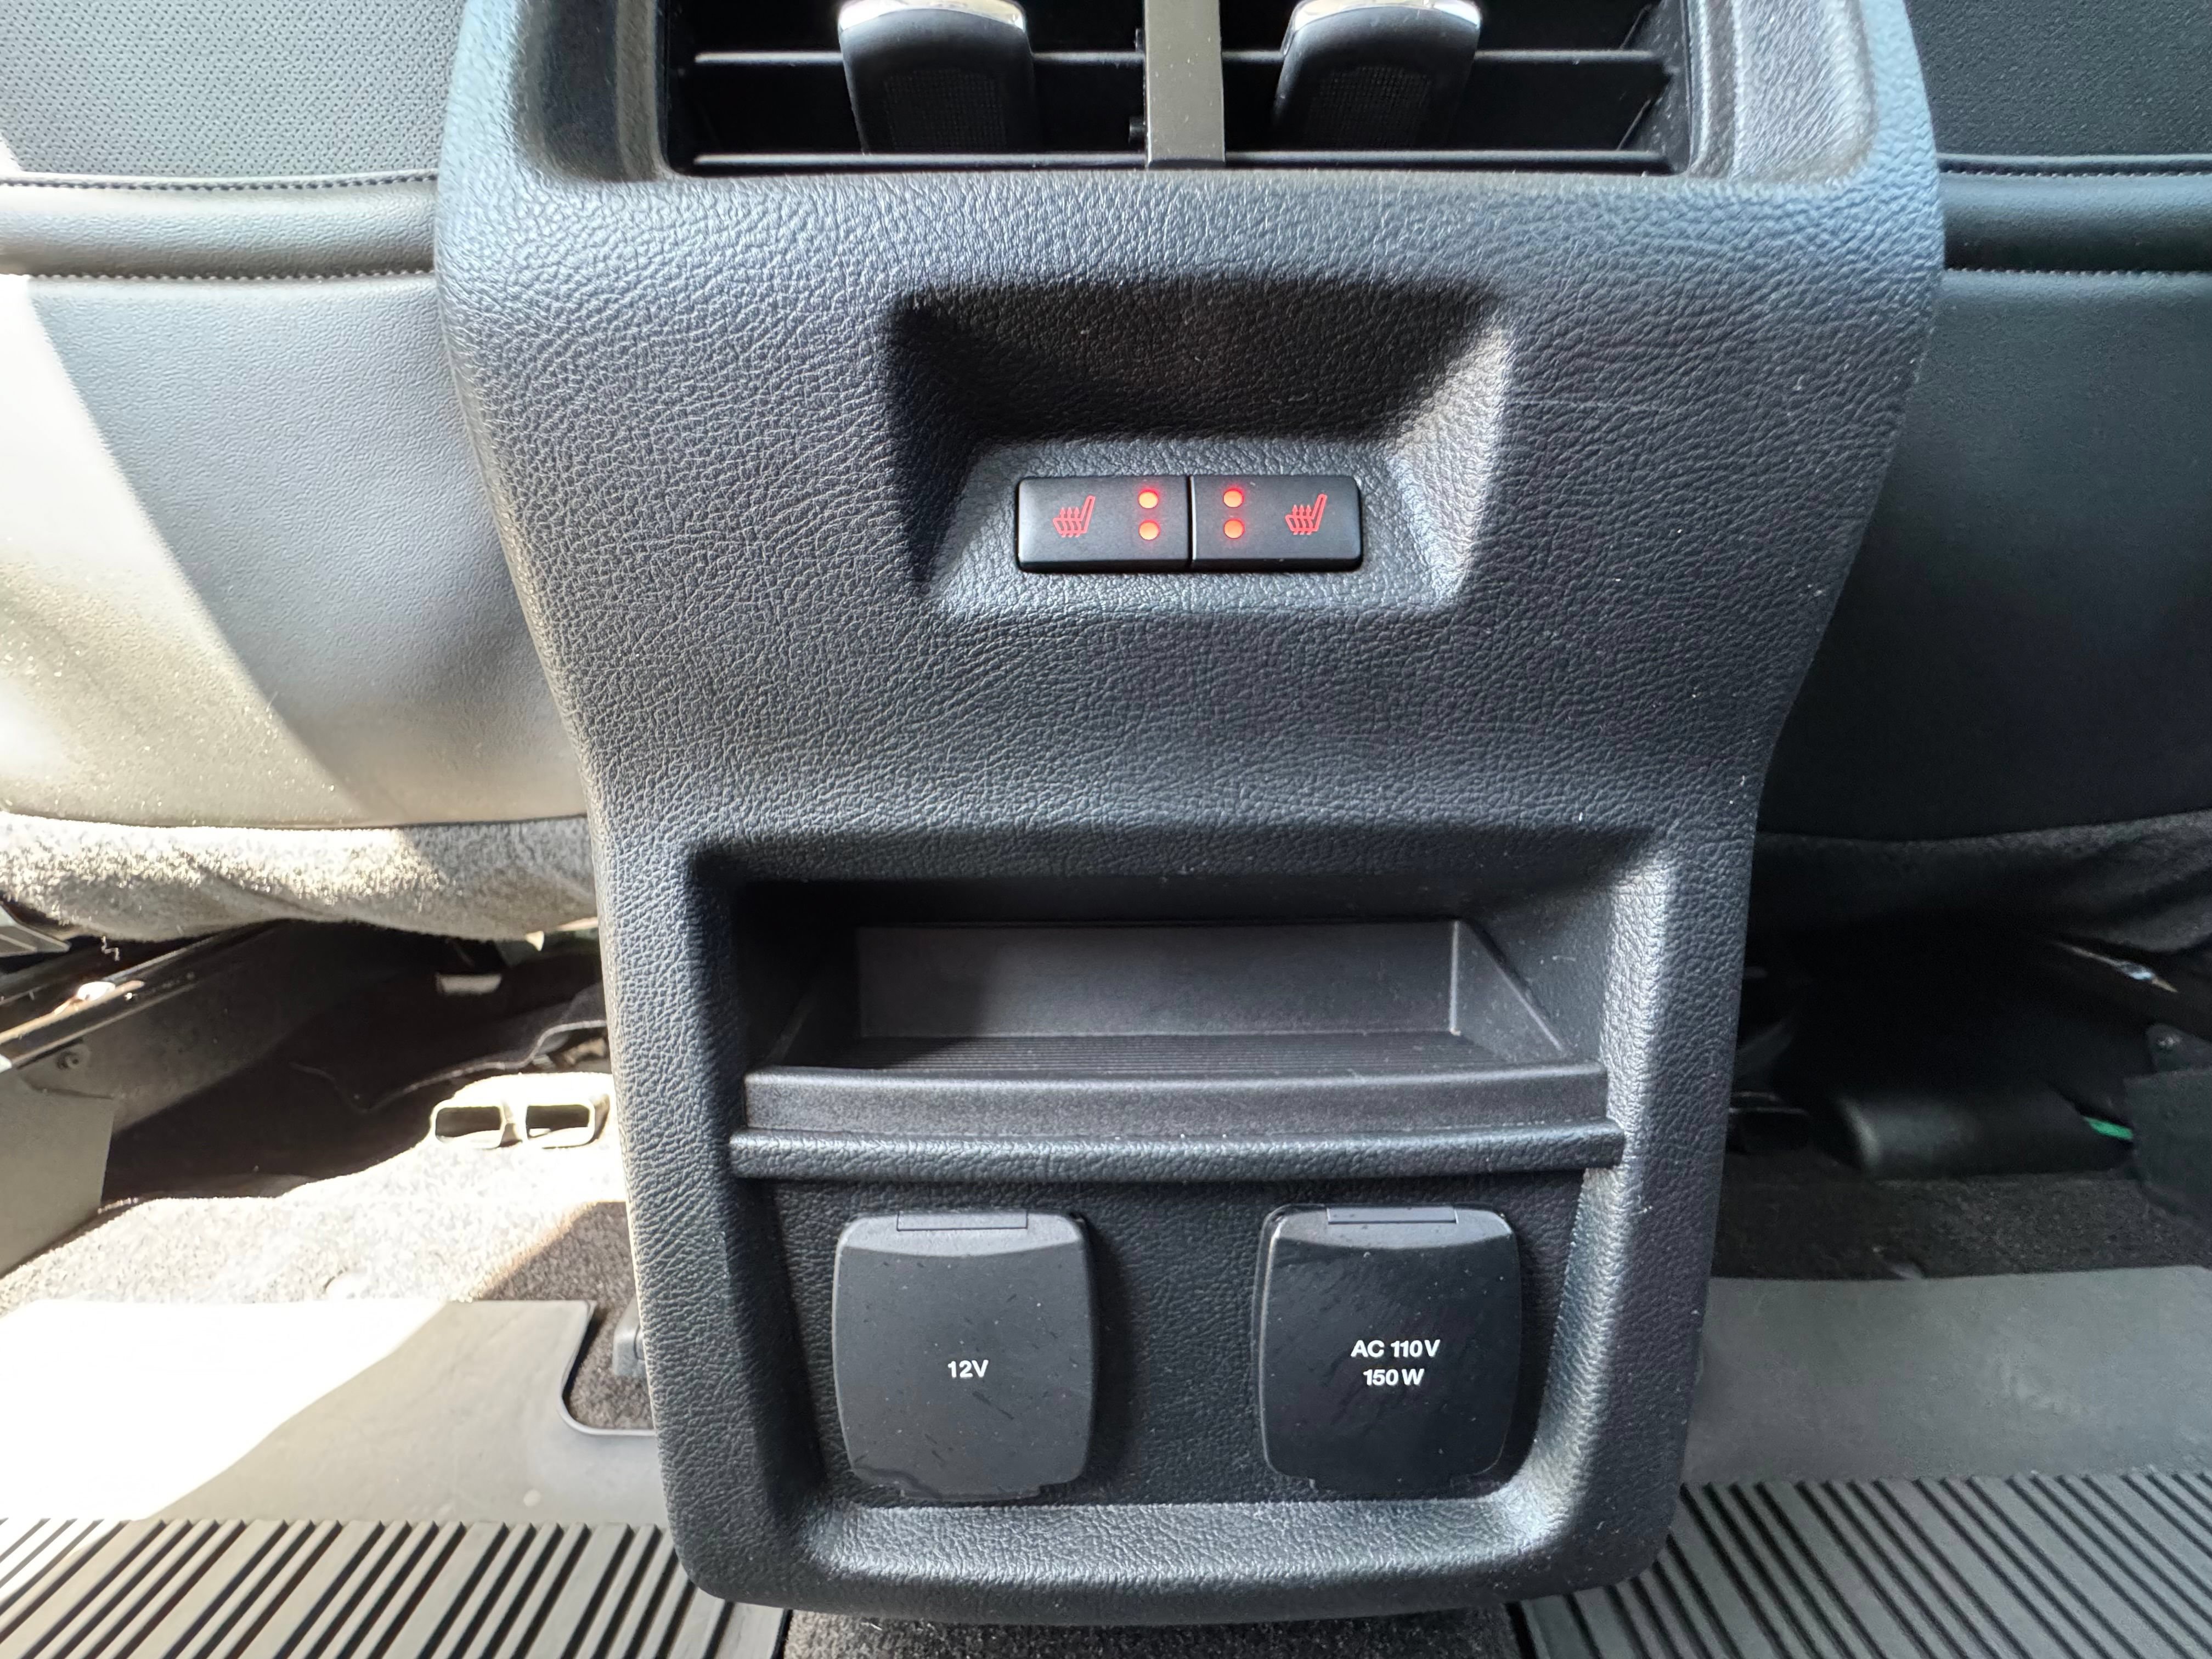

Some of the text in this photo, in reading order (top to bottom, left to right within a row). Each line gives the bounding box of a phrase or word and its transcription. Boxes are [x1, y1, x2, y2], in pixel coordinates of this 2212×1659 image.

[1350, 1339, 1441, 1358] AC 110V
[947, 1359, 989, 1379] 12V
